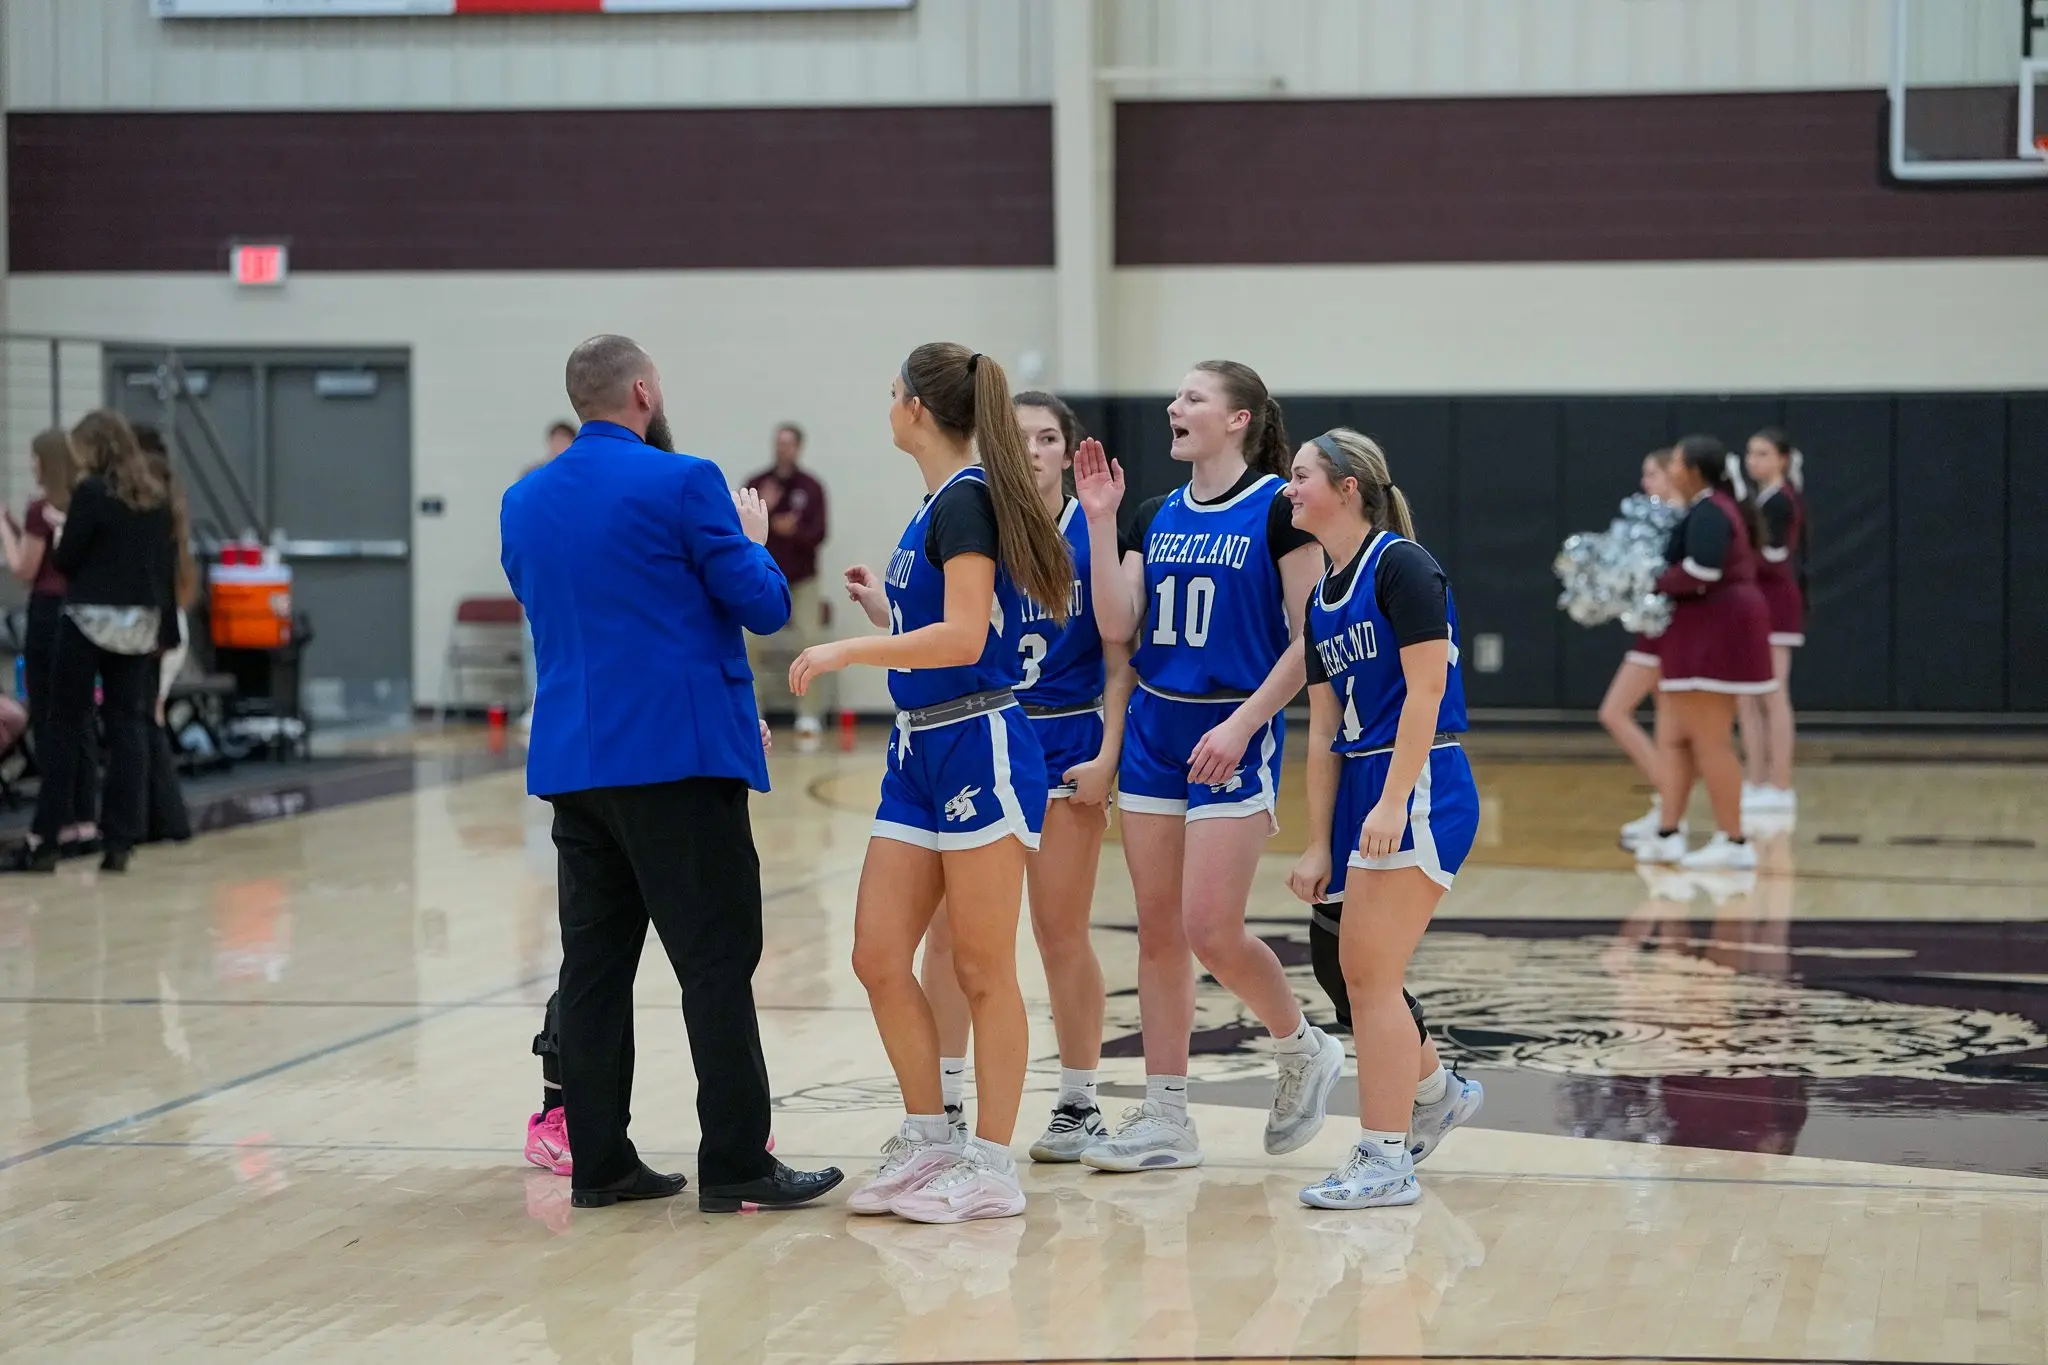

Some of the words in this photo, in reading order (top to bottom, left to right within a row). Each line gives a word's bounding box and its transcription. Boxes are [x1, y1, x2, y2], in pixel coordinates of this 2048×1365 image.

[1147, 533, 1251, 569] WHEATLAND
[1152, 575, 1216, 648] 10
[1011, 632, 1047, 690] 3
